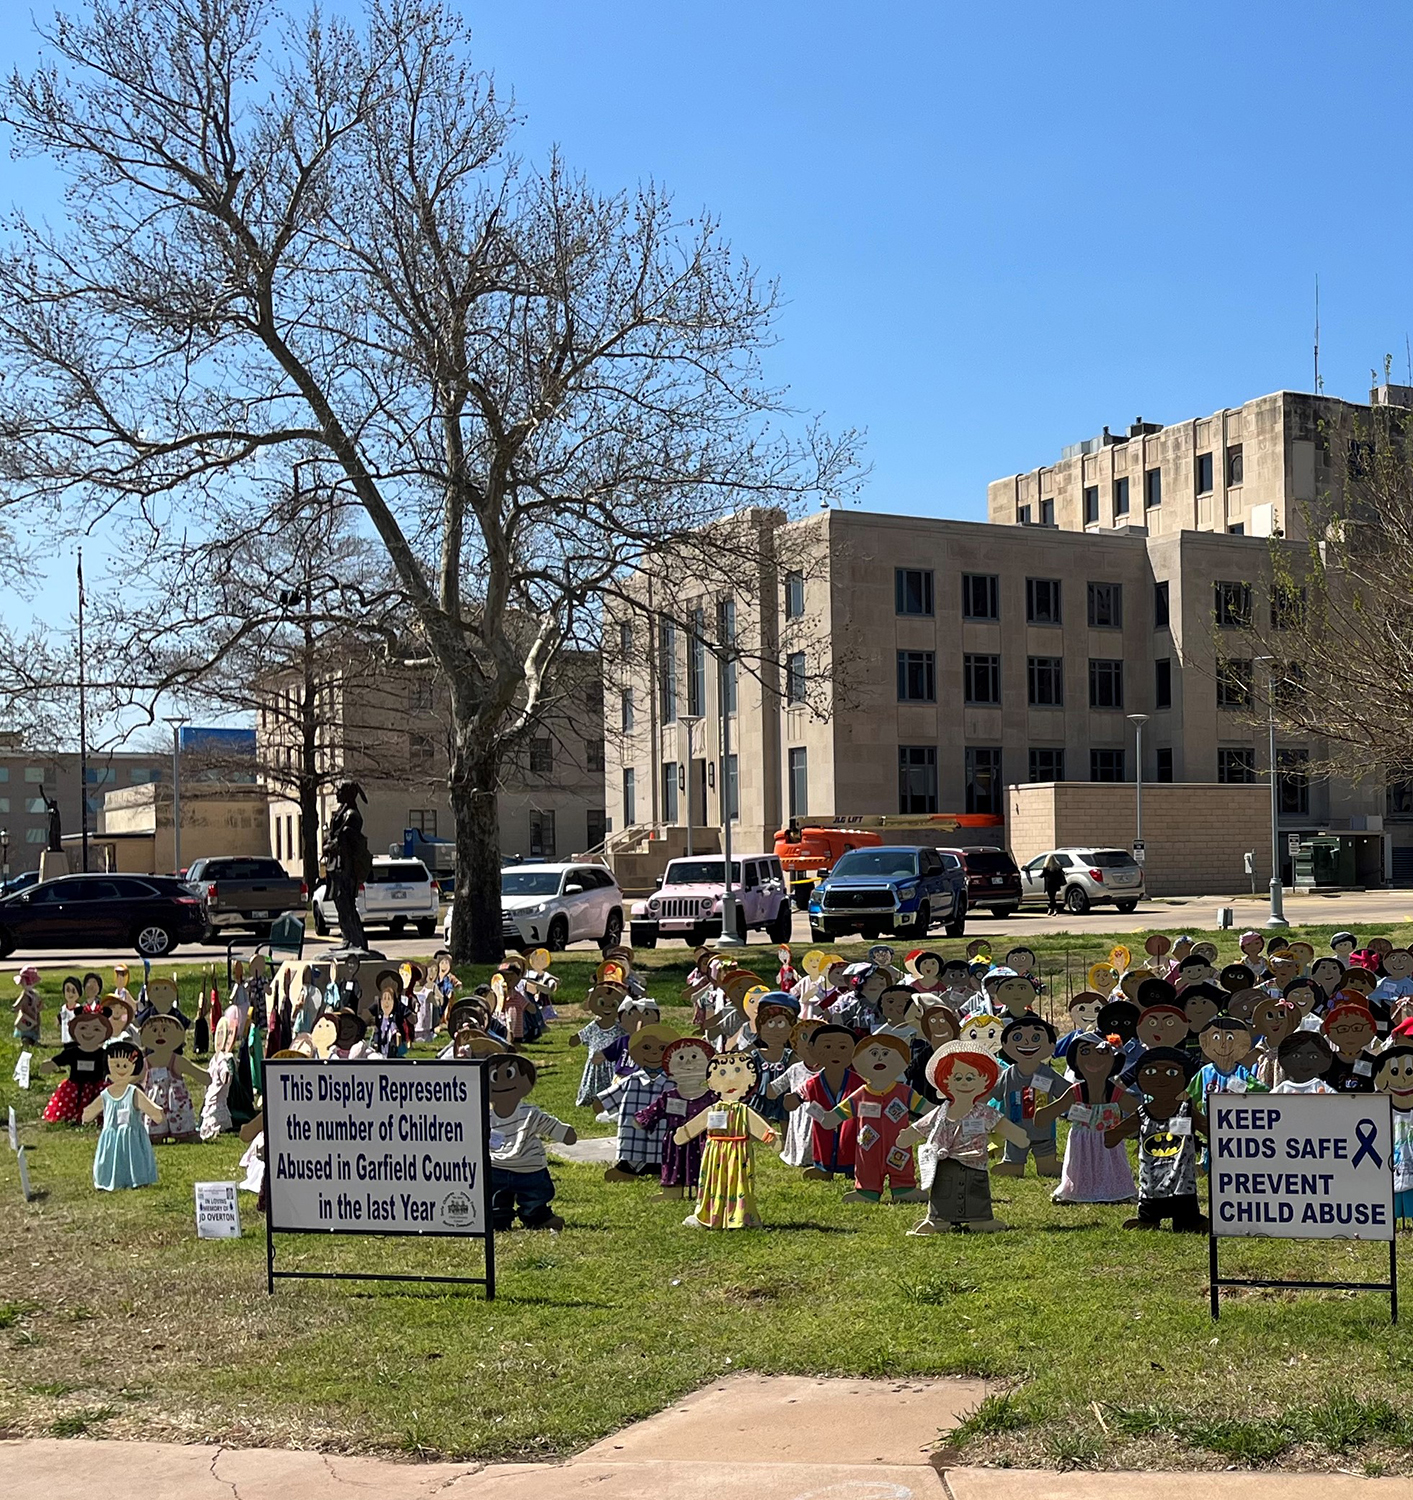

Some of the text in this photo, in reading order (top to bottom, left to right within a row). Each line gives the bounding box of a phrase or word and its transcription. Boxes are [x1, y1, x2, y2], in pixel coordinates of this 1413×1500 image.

[280, 1075, 467, 1108] This Display Represents
[287, 1114, 463, 1142] the number of Children
[1217, 1109, 1281, 1130] KEEP
[1218, 1137, 1348, 1159] KIDS SAFE
[277, 1153, 477, 1189] Abused in Garfield County
[1219, 1173, 1334, 1195] PREVENT
[207, 1213, 235, 1221] OVERTON
[319, 1193, 332, 1219] in
[337, 1193, 362, 1220] the
[367, 1193, 396, 1220] last
[400, 1193, 435, 1221] Year
[1219, 1201, 1386, 1225] CHILD ABUSE
